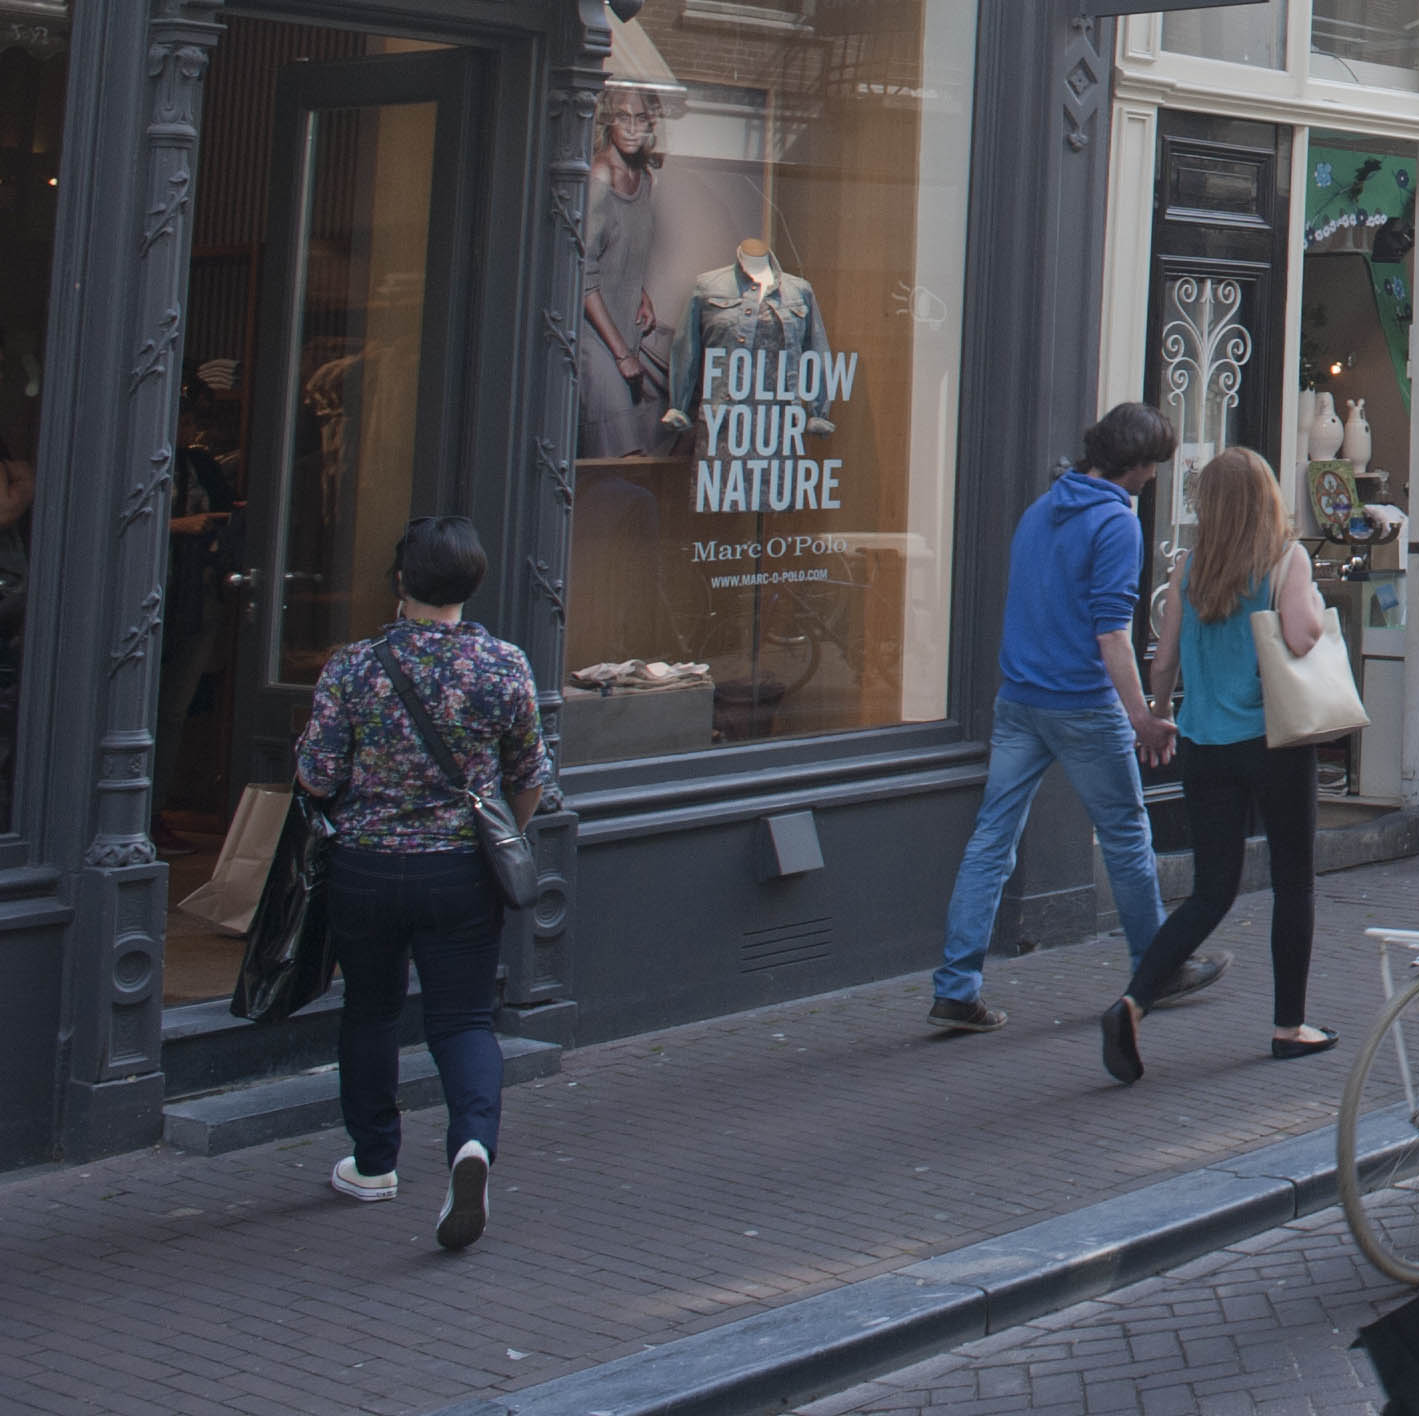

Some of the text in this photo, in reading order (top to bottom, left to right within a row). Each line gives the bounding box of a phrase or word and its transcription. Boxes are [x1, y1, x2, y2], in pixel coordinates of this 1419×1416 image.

[702, 347, 858, 402] FOLLOW
[703, 404, 807, 457] YOUR
[696, 459, 843, 513] NATURE
[691, 535, 848, 562] Marc O'Polo
[711, 568, 828, 589] WWW.MARC-O-POLO.COM
